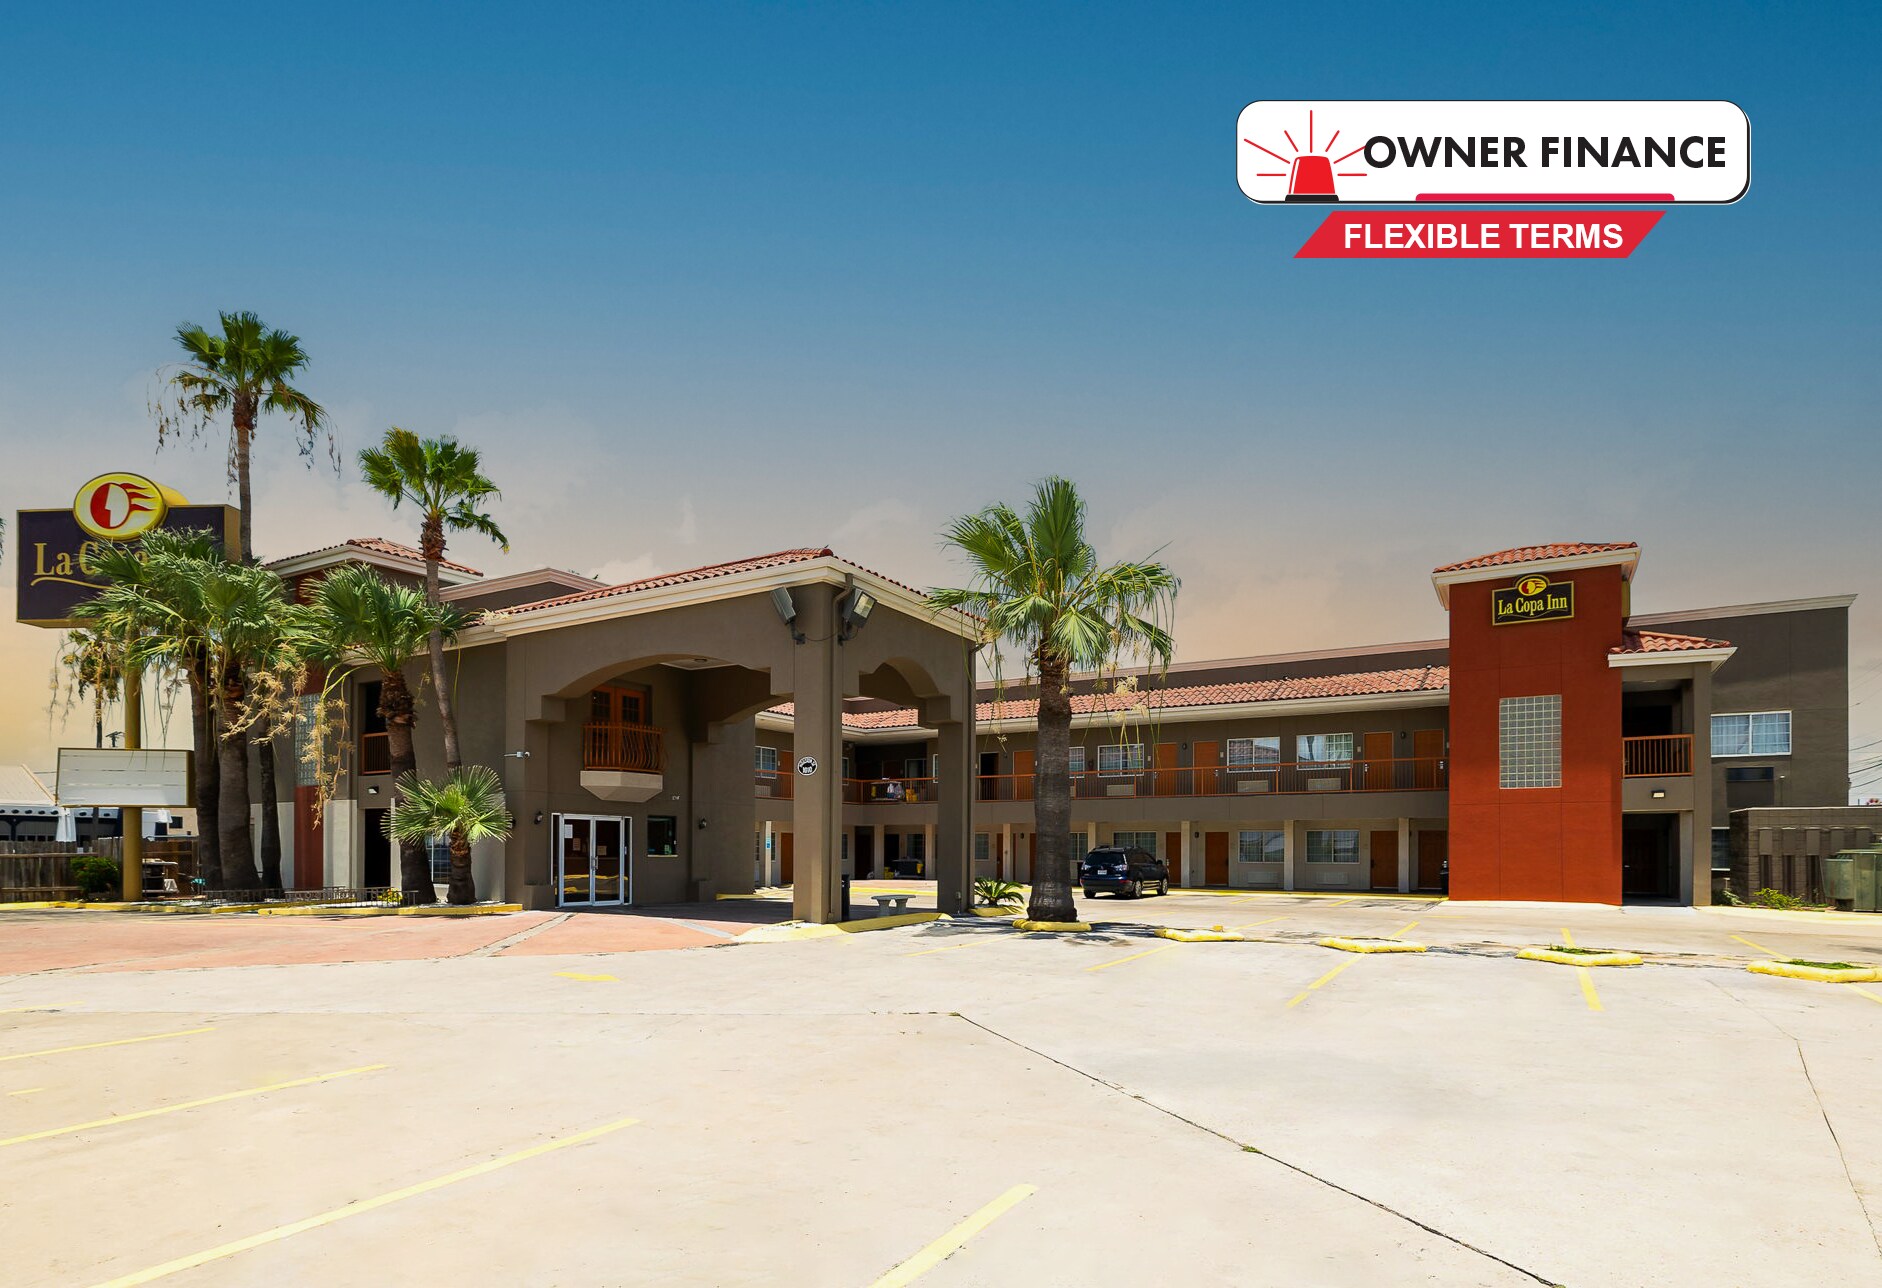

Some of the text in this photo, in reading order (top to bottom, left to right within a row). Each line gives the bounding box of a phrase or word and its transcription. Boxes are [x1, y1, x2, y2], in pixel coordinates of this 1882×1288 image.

[33, 542, 74, 576] La
[1498, 594, 1568, 616] La Copa Inn
